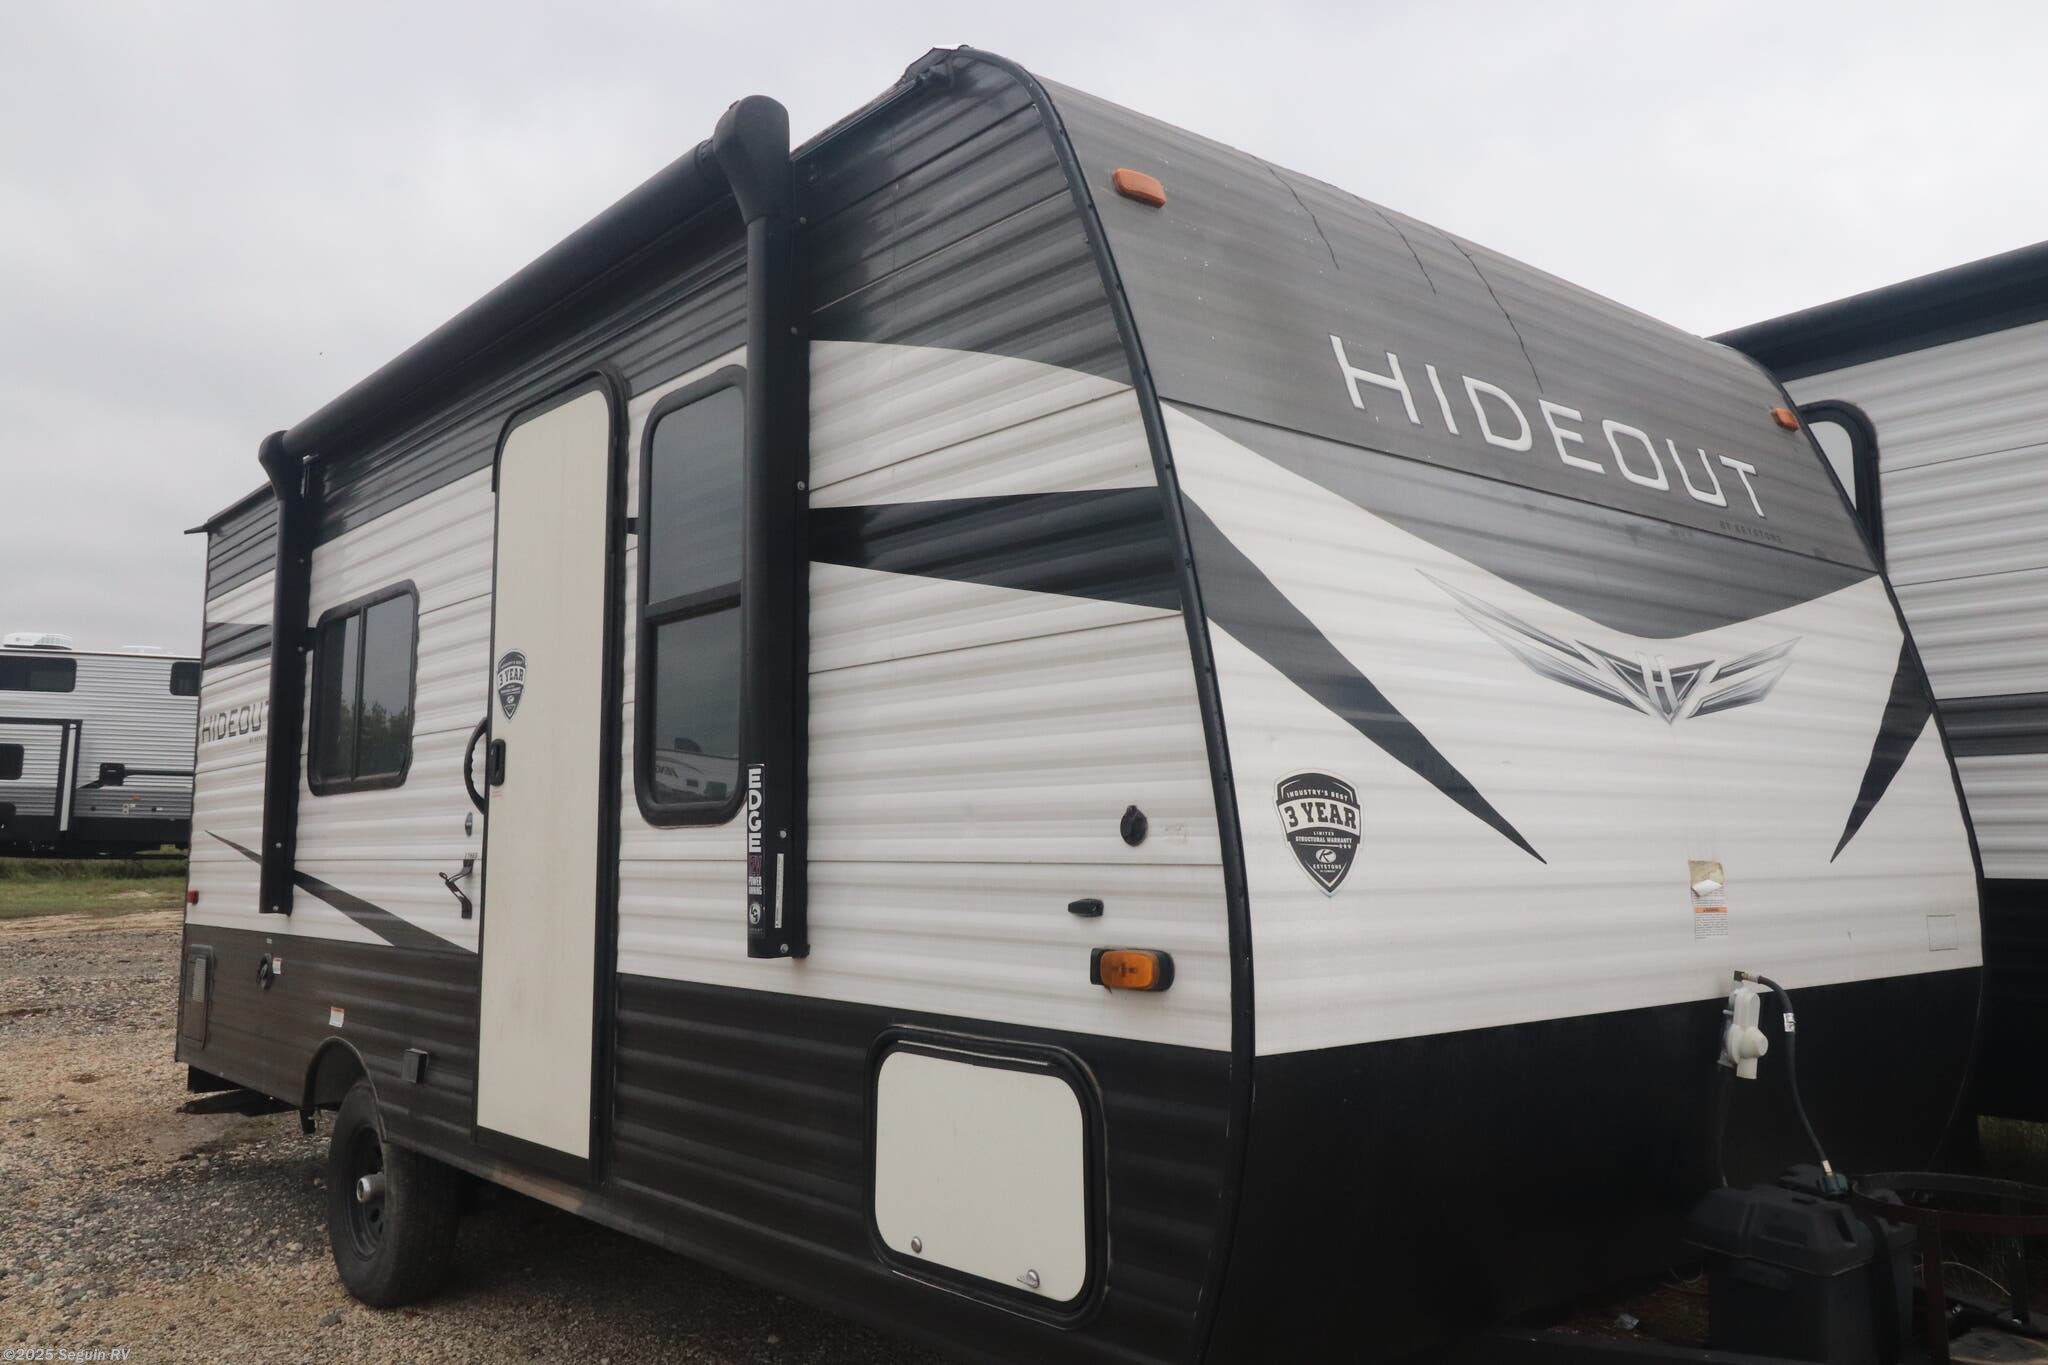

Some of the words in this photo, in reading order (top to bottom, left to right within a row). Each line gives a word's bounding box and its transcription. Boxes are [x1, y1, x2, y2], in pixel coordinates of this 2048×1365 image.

[1329, 334, 1766, 518] HIDEOUT
[504, 667, 524, 683] YEAR
[1286, 789, 1328, 799] INDUSTRY'S
[1331, 790, 1348, 801] BEST
[748, 768, 762, 853] EDGE
[1284, 805, 1299, 828] 3
[1300, 801, 1357, 830] YEAR
